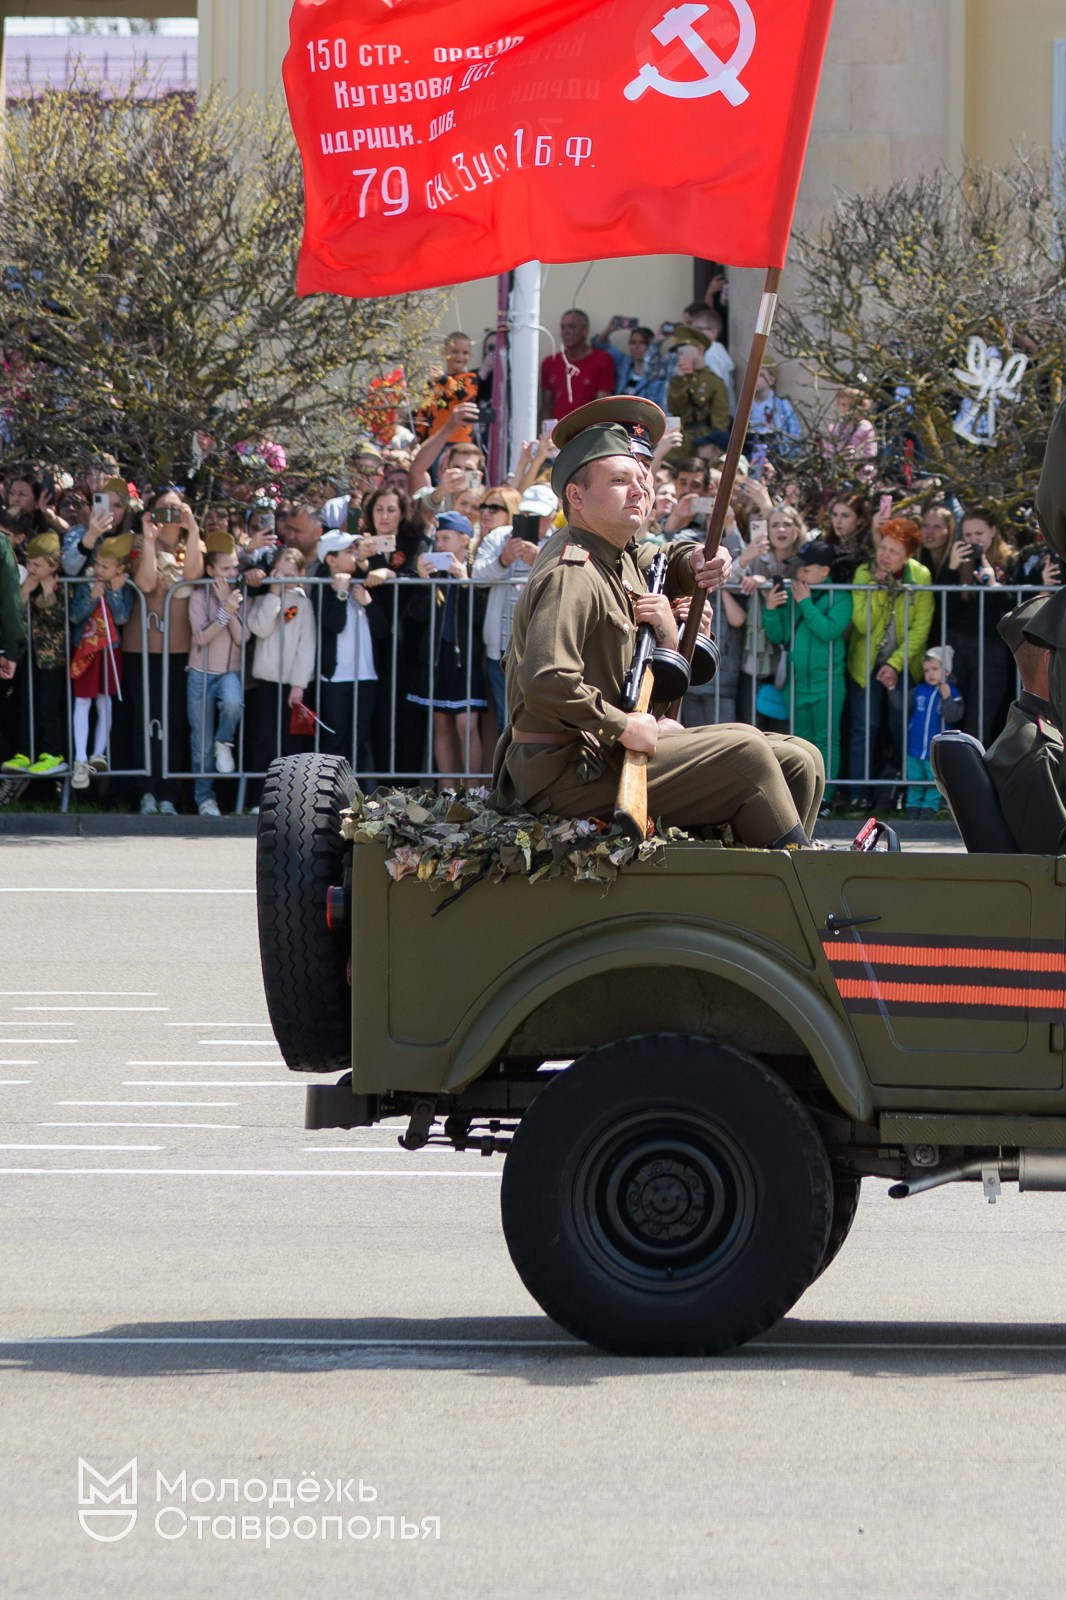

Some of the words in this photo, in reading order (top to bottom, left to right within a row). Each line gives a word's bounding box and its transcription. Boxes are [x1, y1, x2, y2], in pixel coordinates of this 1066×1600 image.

[306, 38, 347, 72] 150
[352, 166, 410, 218] 79
[513, 128, 524, 168] 1
